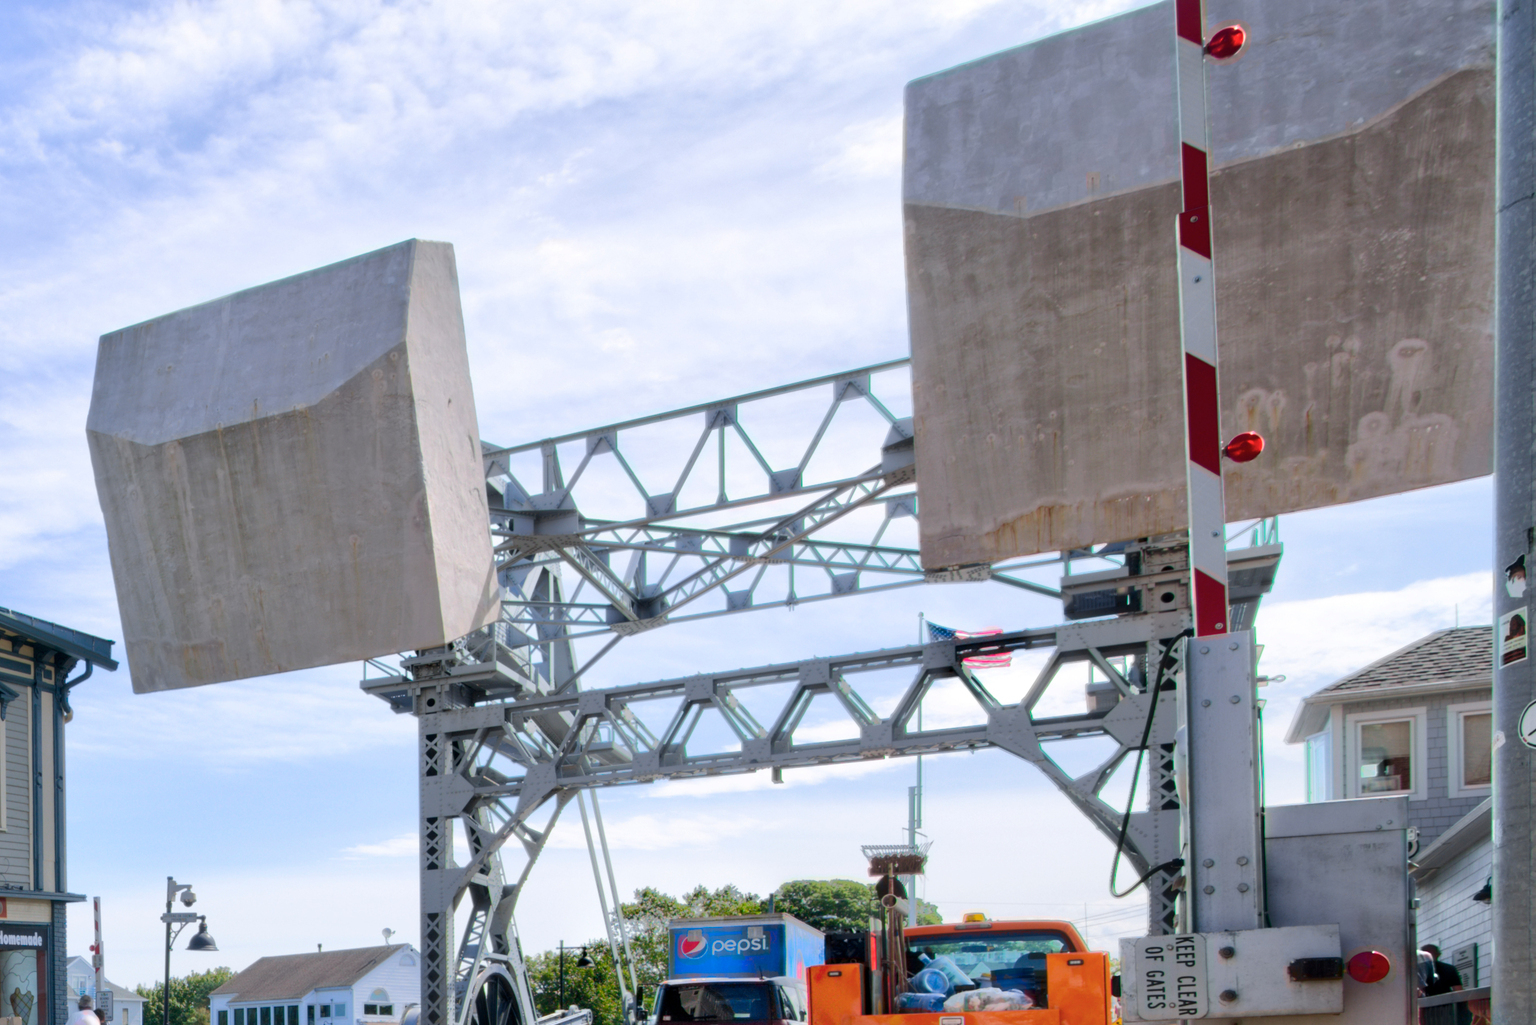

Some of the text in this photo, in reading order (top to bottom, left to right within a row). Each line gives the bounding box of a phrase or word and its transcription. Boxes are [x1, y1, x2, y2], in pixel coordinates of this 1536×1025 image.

[712, 935, 766, 956] pepsi
[1175, 936, 1198, 1016] KEEP CLEAR
[1145, 946, 1166, 1009] OF GATES
